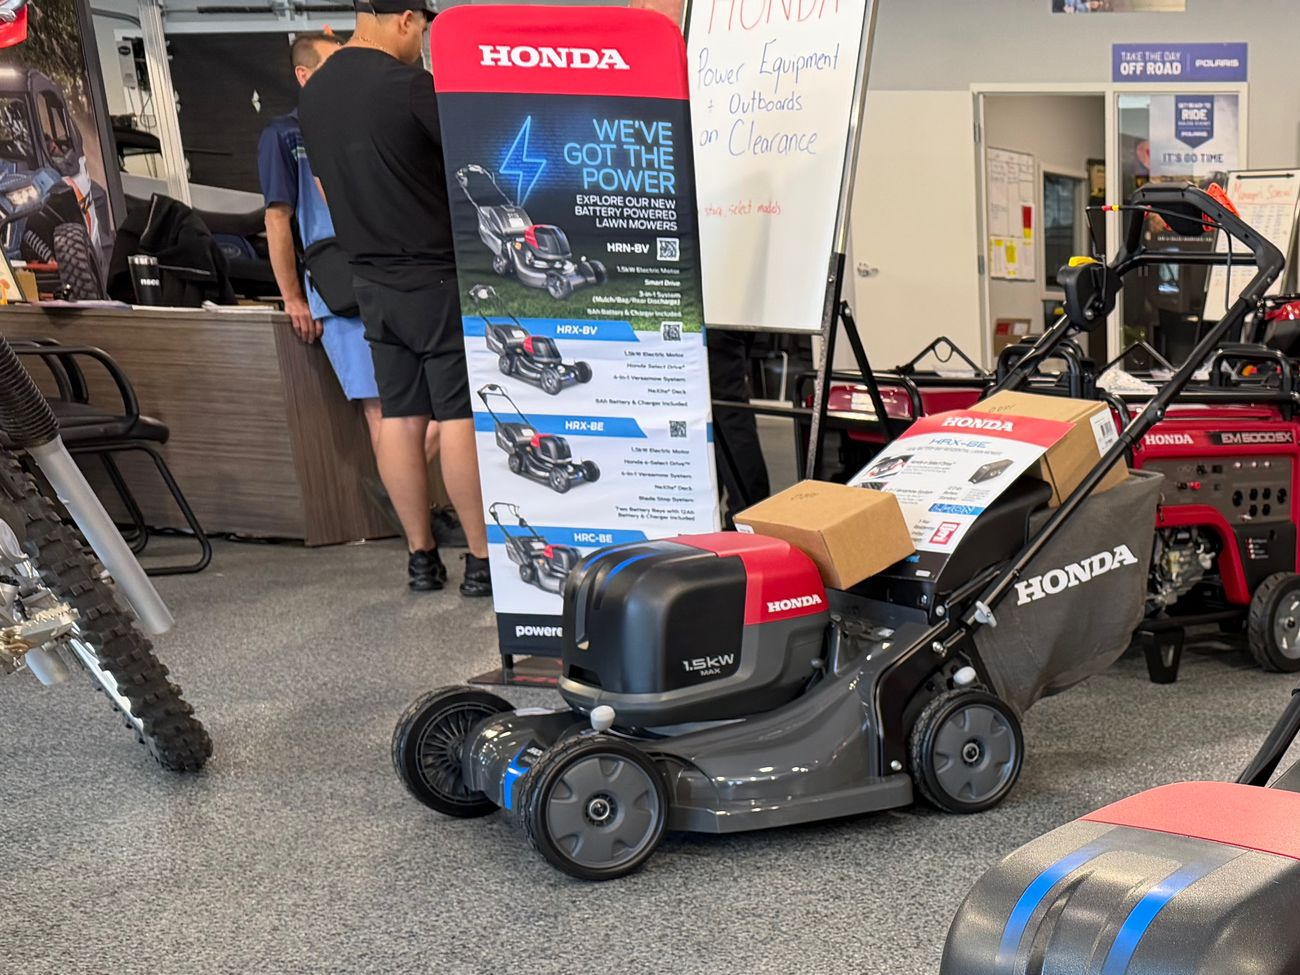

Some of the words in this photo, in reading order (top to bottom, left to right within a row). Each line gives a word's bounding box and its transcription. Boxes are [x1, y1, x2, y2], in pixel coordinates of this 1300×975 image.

[479, 45, 630, 70] HONDA
[1121, 51, 1142, 61] TAKE
[1145, 51, 1162, 61] THE
[1163, 51, 1182, 60] DAY
[1195, 58, 1239, 68] POLARIS
[697, 47, 744, 88] Power
[759, 38, 840, 94] Equipment
[1120, 62, 1145, 75] OFF
[1146, 61, 1182, 75] ROAD
[729, 90, 803, 115] Outboards
[1181, 108, 1208, 121] RIDE
[592, 118, 673, 145] WE'VE
[728, 118, 818, 157] Clearance
[563, 142, 617, 166] GOT
[623, 144, 674, 170] THE
[1162, 153, 1182, 163] IT'S
[1184, 153, 1198, 163] GO
[1200, 153, 1224, 163] TIME
[582, 167, 676, 195] POWER
[576, 194, 624, 206] EXPLORE
[625, 196, 649, 207] OUR
[651, 198, 676, 209] NEW
[575, 206, 622, 217] BATTERY
[623, 207, 677, 220] POWERED
[596, 218, 627, 229] LAWN
[628, 219, 678, 231] MOWERS
[644, 279, 664, 287] Smart
[564, 420, 604, 431] HRX-BE
[941, 416, 1015, 432] HONDA
[1144, 433, 1194, 446] HONDA
[1014, 543, 1138, 607] HONDA
[767, 594, 823, 612] HONDA
[682, 653, 735, 672] 1.5kW
[700, 668, 721, 677] MAX
